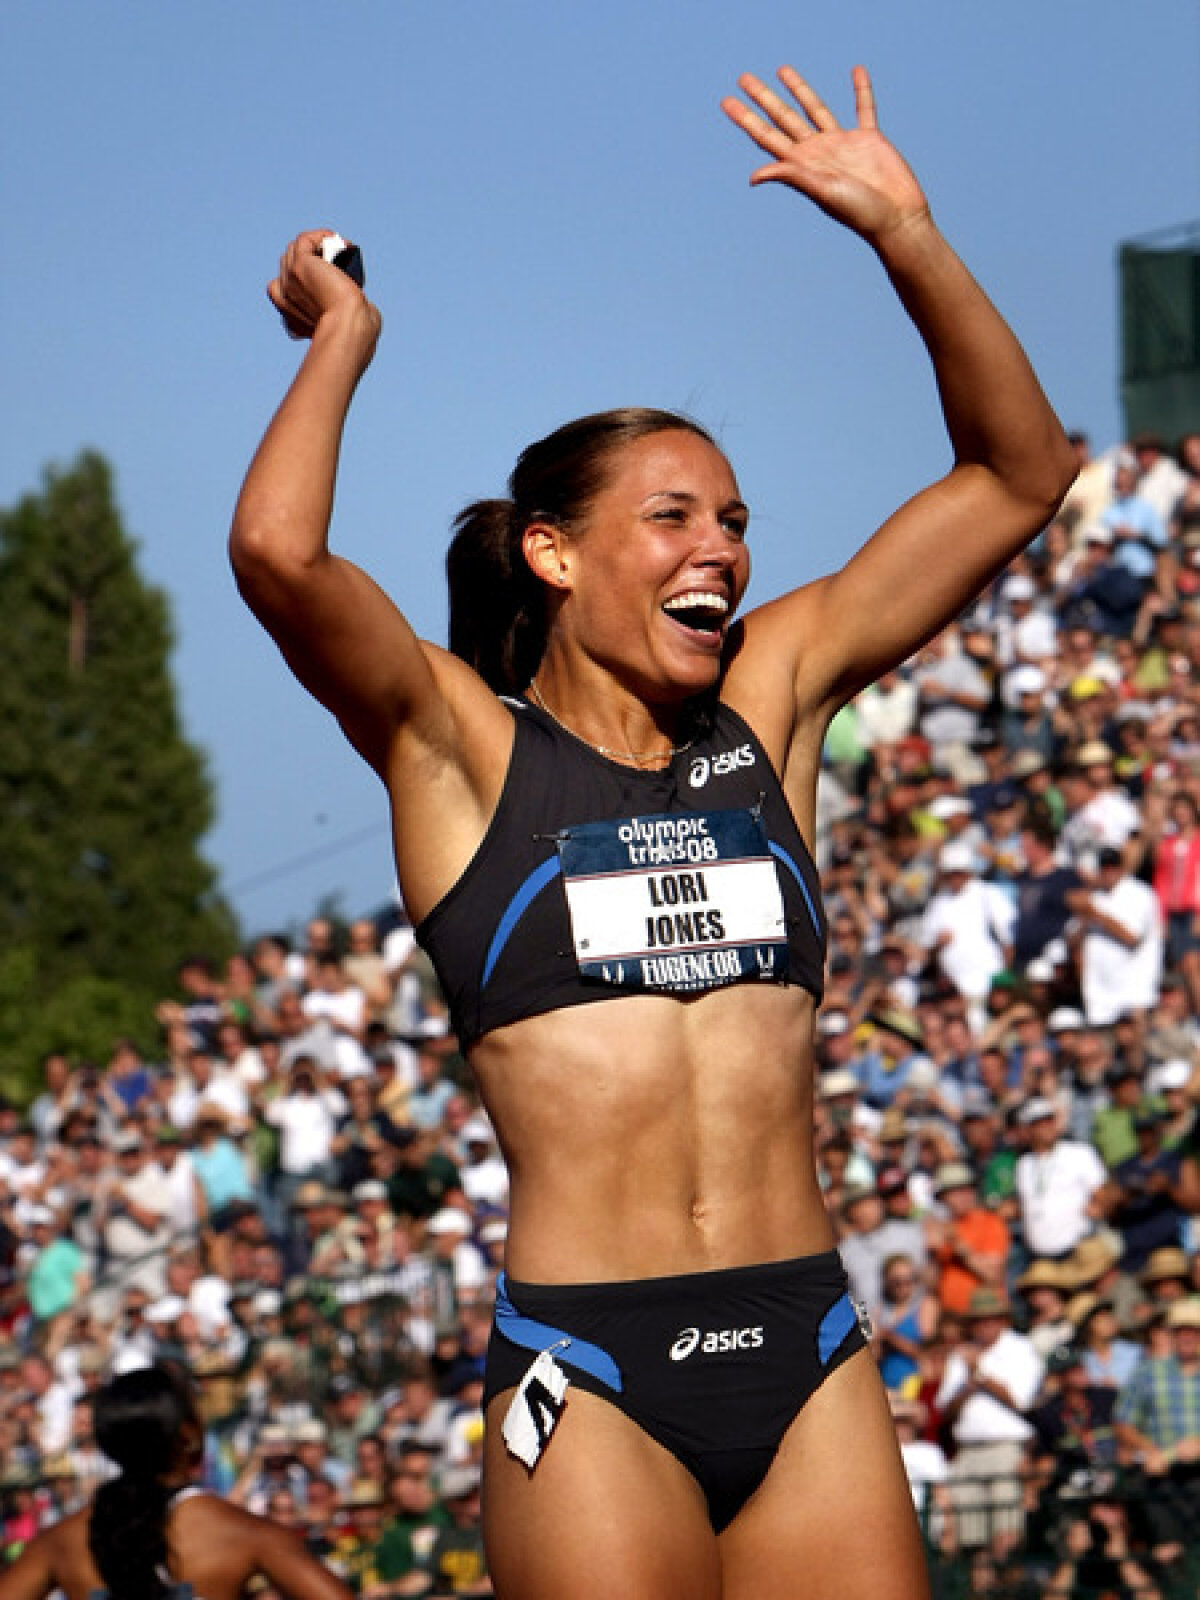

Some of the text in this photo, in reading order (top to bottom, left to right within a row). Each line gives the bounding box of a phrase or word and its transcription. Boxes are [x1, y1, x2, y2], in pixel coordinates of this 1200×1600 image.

[618, 818, 710, 847] olympic
[648, 872, 708, 907] LORI
[645, 909, 726, 947] JONES
[702, 1327, 764, 1353] asics
